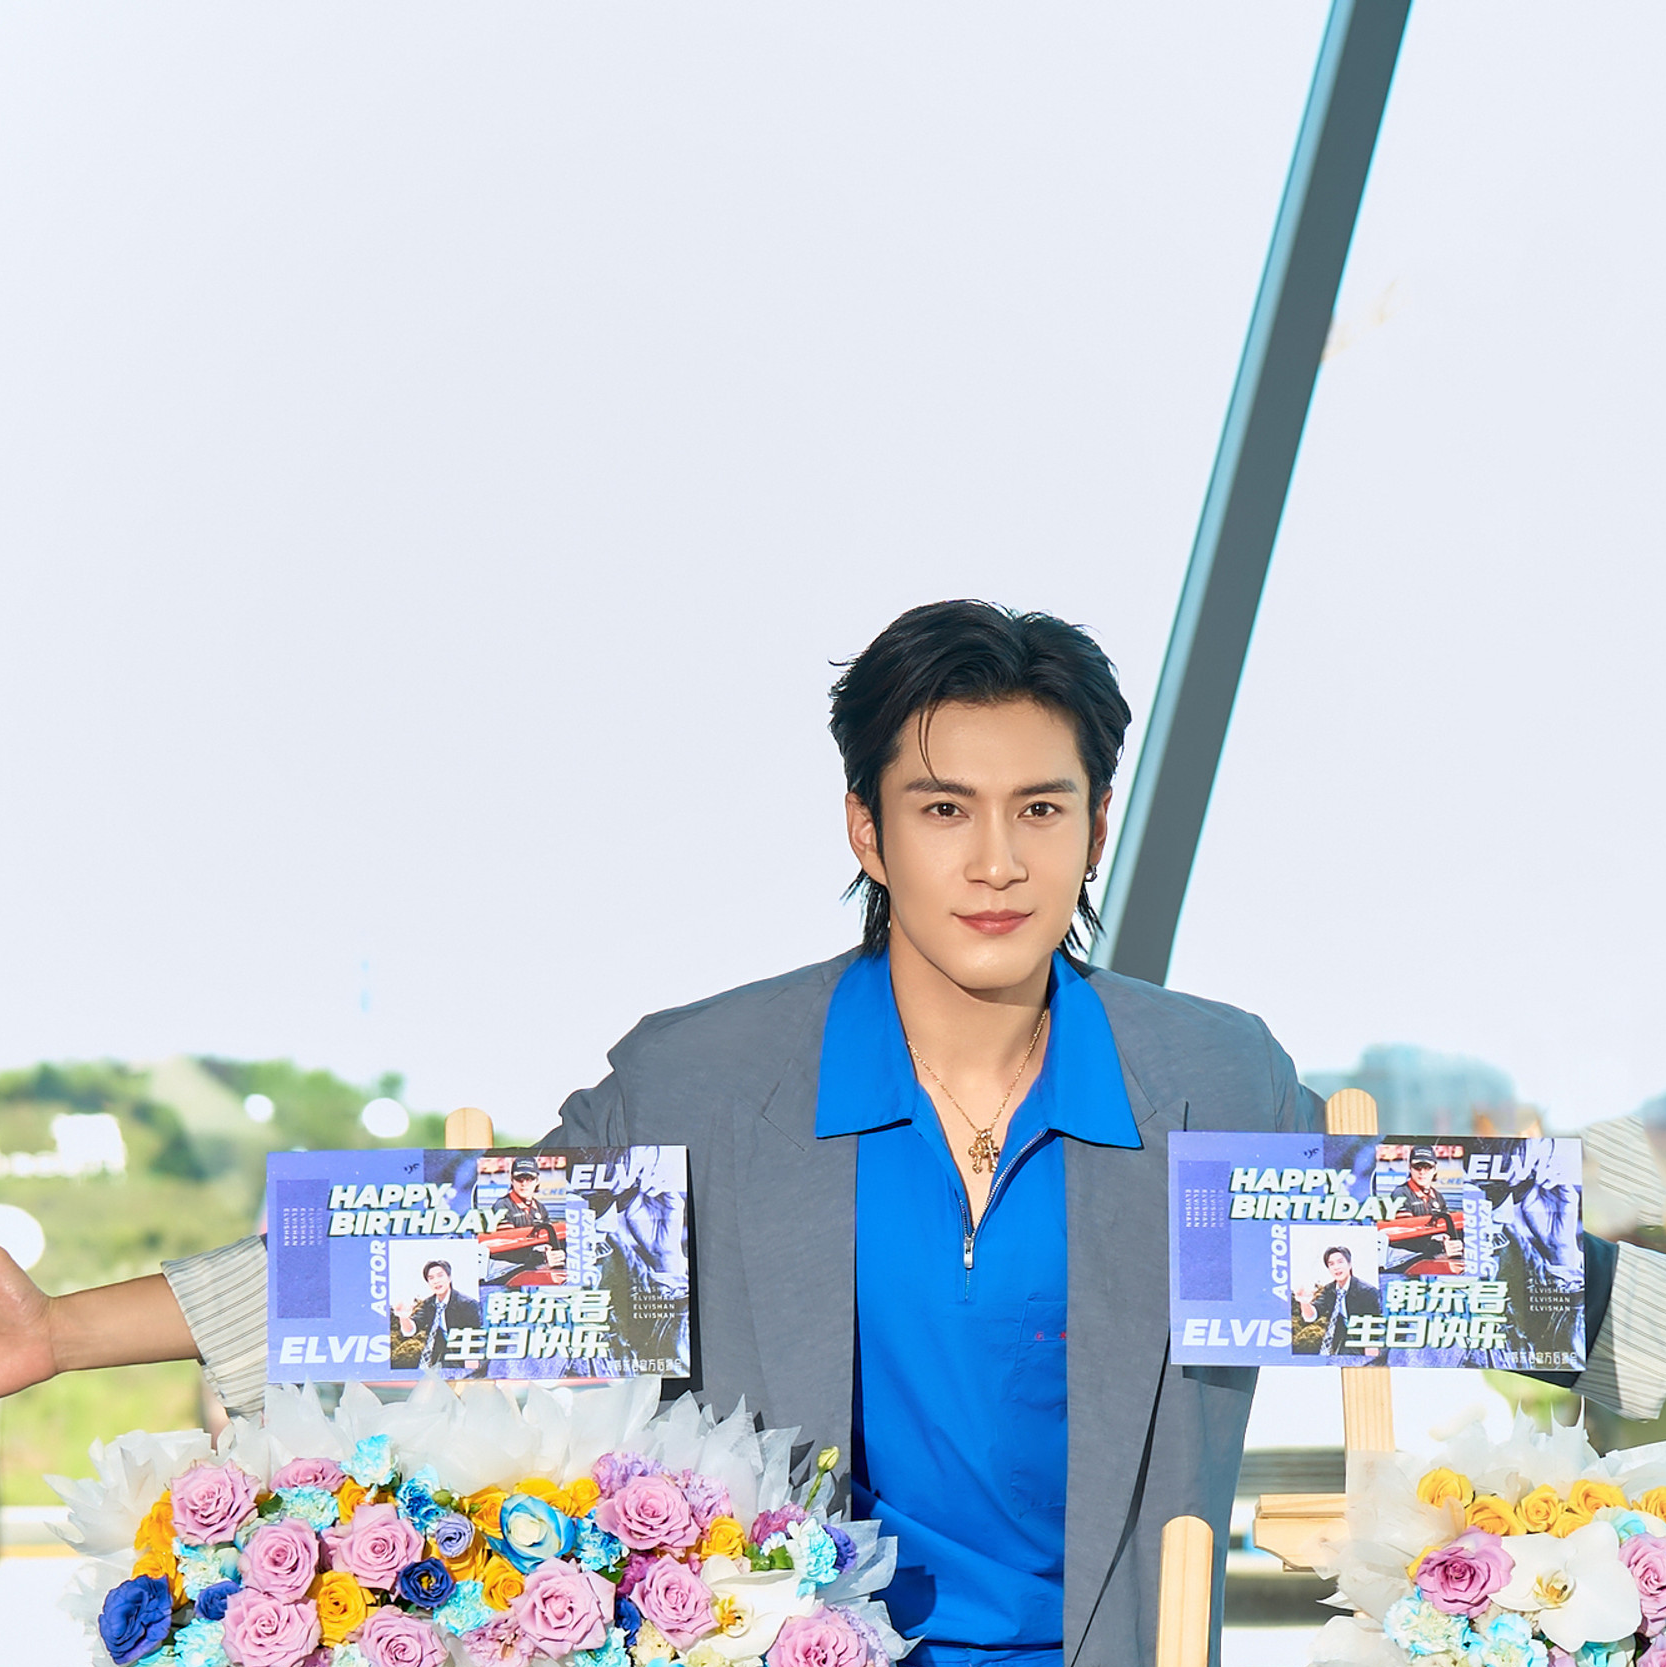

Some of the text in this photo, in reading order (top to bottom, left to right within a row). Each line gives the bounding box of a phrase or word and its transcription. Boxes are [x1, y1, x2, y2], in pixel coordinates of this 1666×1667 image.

[328, 1183, 452, 1210] HAPPY
[1229, 1167, 1352, 1194] HAPPY
[327, 1208, 508, 1237] BIRTHDAY
[1229, 1193, 1407, 1222] BIRTHDAY
[566, 1208, 581, 1282] DRIVER
[581, 1208, 600, 1286] RACING
[1463, 1200, 1478, 1274] DRIVER
[1478, 1199, 1496, 1277] RACING
[370, 1240, 388, 1317] ACTOR
[1271, 1223, 1289, 1301] ACTOR
[486, 1289, 612, 1325] 韩东君
[1386, 1279, 1509, 1315] 韩东君
[280, 1334, 390, 1364] ELVIS
[445, 1324, 610, 1362] 生日快乐
[1182, 1318, 1292, 1348] ELVIS
[1345, 1314, 1509, 1350] 生日快乐
